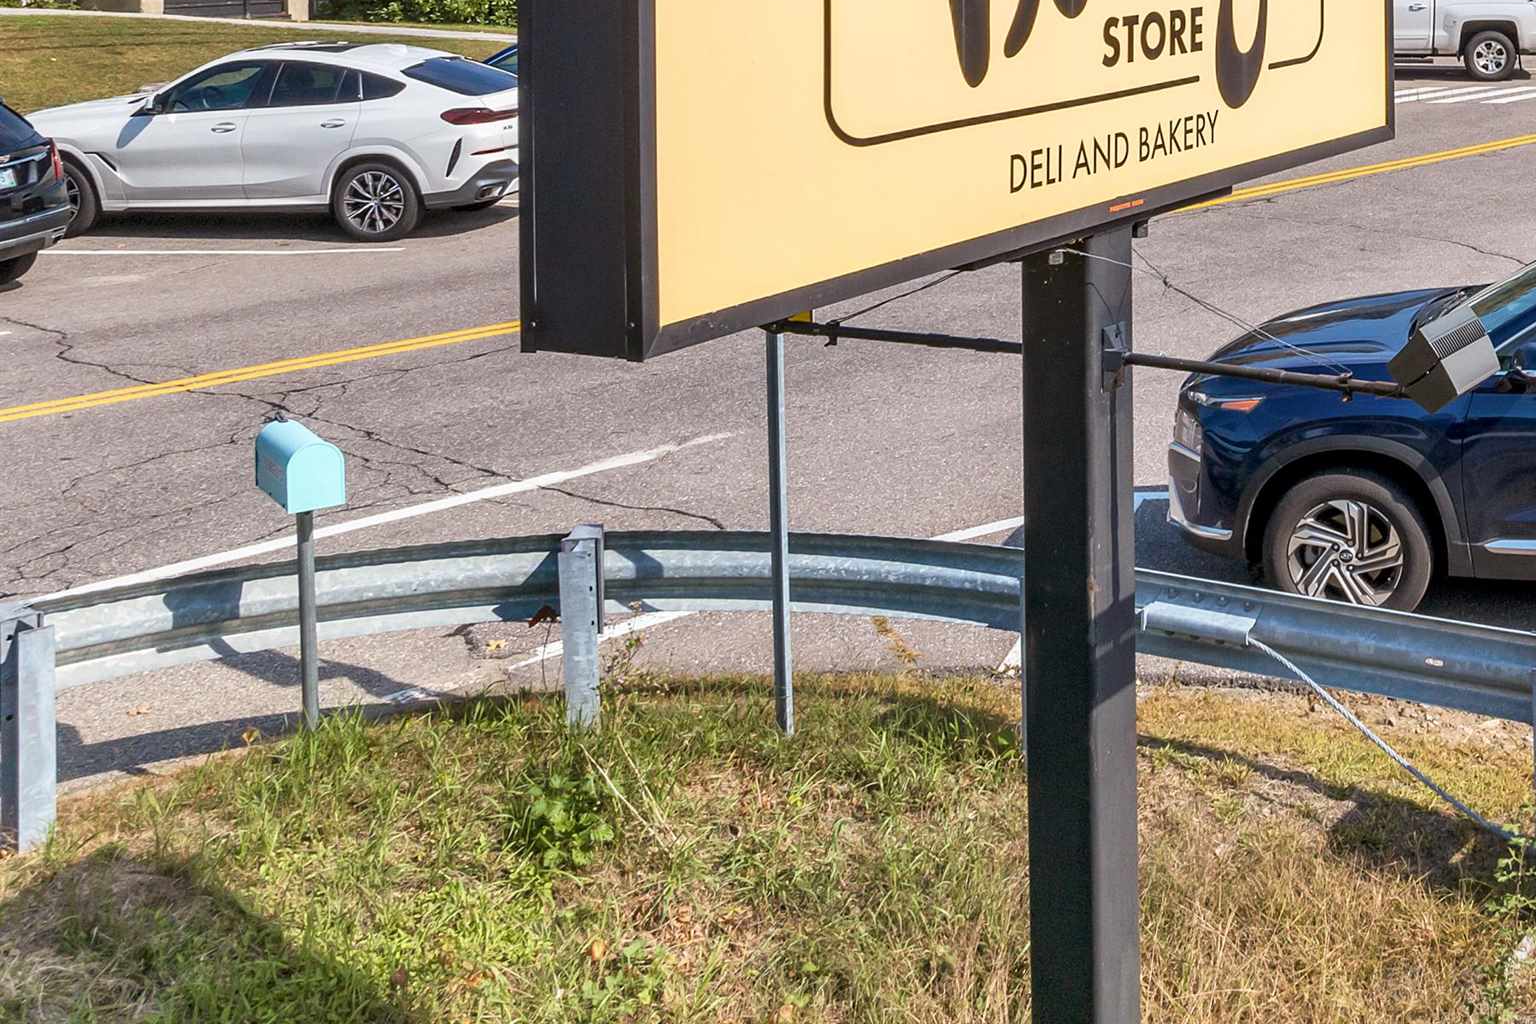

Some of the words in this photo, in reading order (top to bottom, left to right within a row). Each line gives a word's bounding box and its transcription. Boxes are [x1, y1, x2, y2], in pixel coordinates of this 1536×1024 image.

[1102, 6, 1203, 68] STORE
[1010, 144, 1063, 194] DELI
[1072, 131, 1130, 180] AND
[1139, 109, 1219, 163] BAKERY
